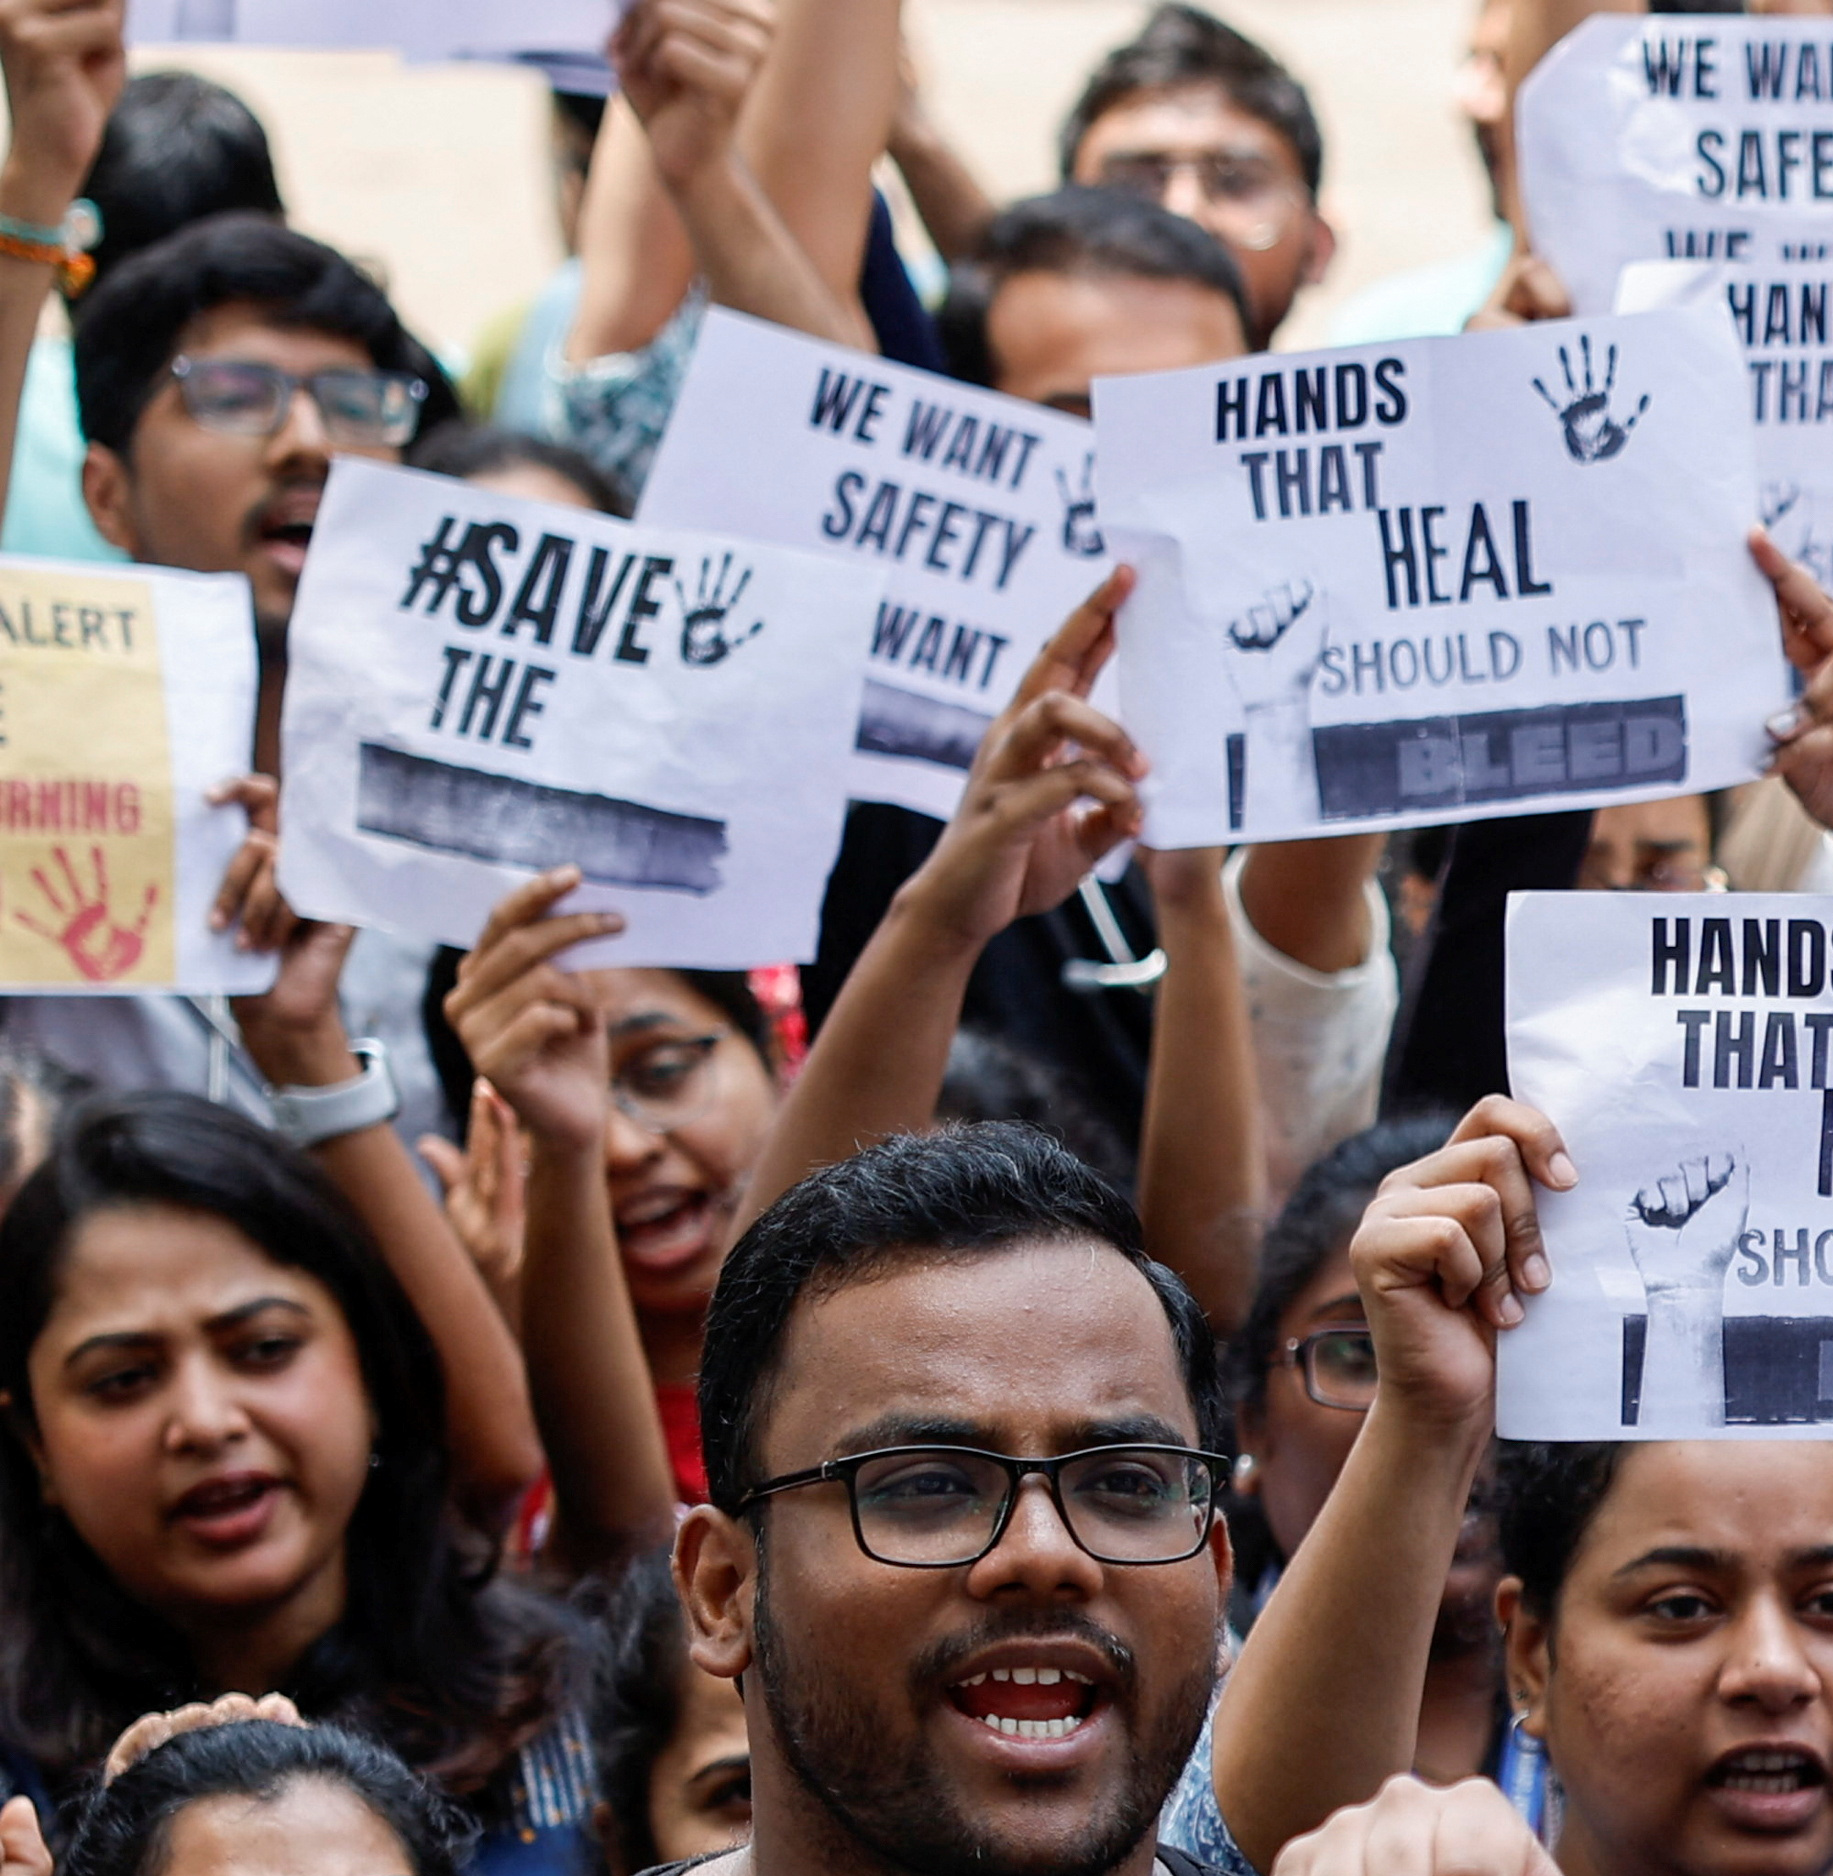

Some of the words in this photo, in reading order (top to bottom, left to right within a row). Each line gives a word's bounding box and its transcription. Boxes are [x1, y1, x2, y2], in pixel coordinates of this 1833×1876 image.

[1642, 39, 1718, 99] WE
[809, 369, 889, 442] WE
[904, 400, 1043, 489] WANT
[1217, 358, 1408, 441] HANDS
[1241, 443, 1382, 520] THAT
[823, 470, 1034, 589] SAFETY
[1378, 501, 1551, 607] HEAL
[399, 515, 674, 664] #SAVE
[871, 602, 1011, 688] WANT
[1322, 632, 1520, 695] SHOULD
[1549, 620, 1645, 674] NOT
[431, 647, 555, 748] THE
[1400, 716, 1683, 793] BLEED
